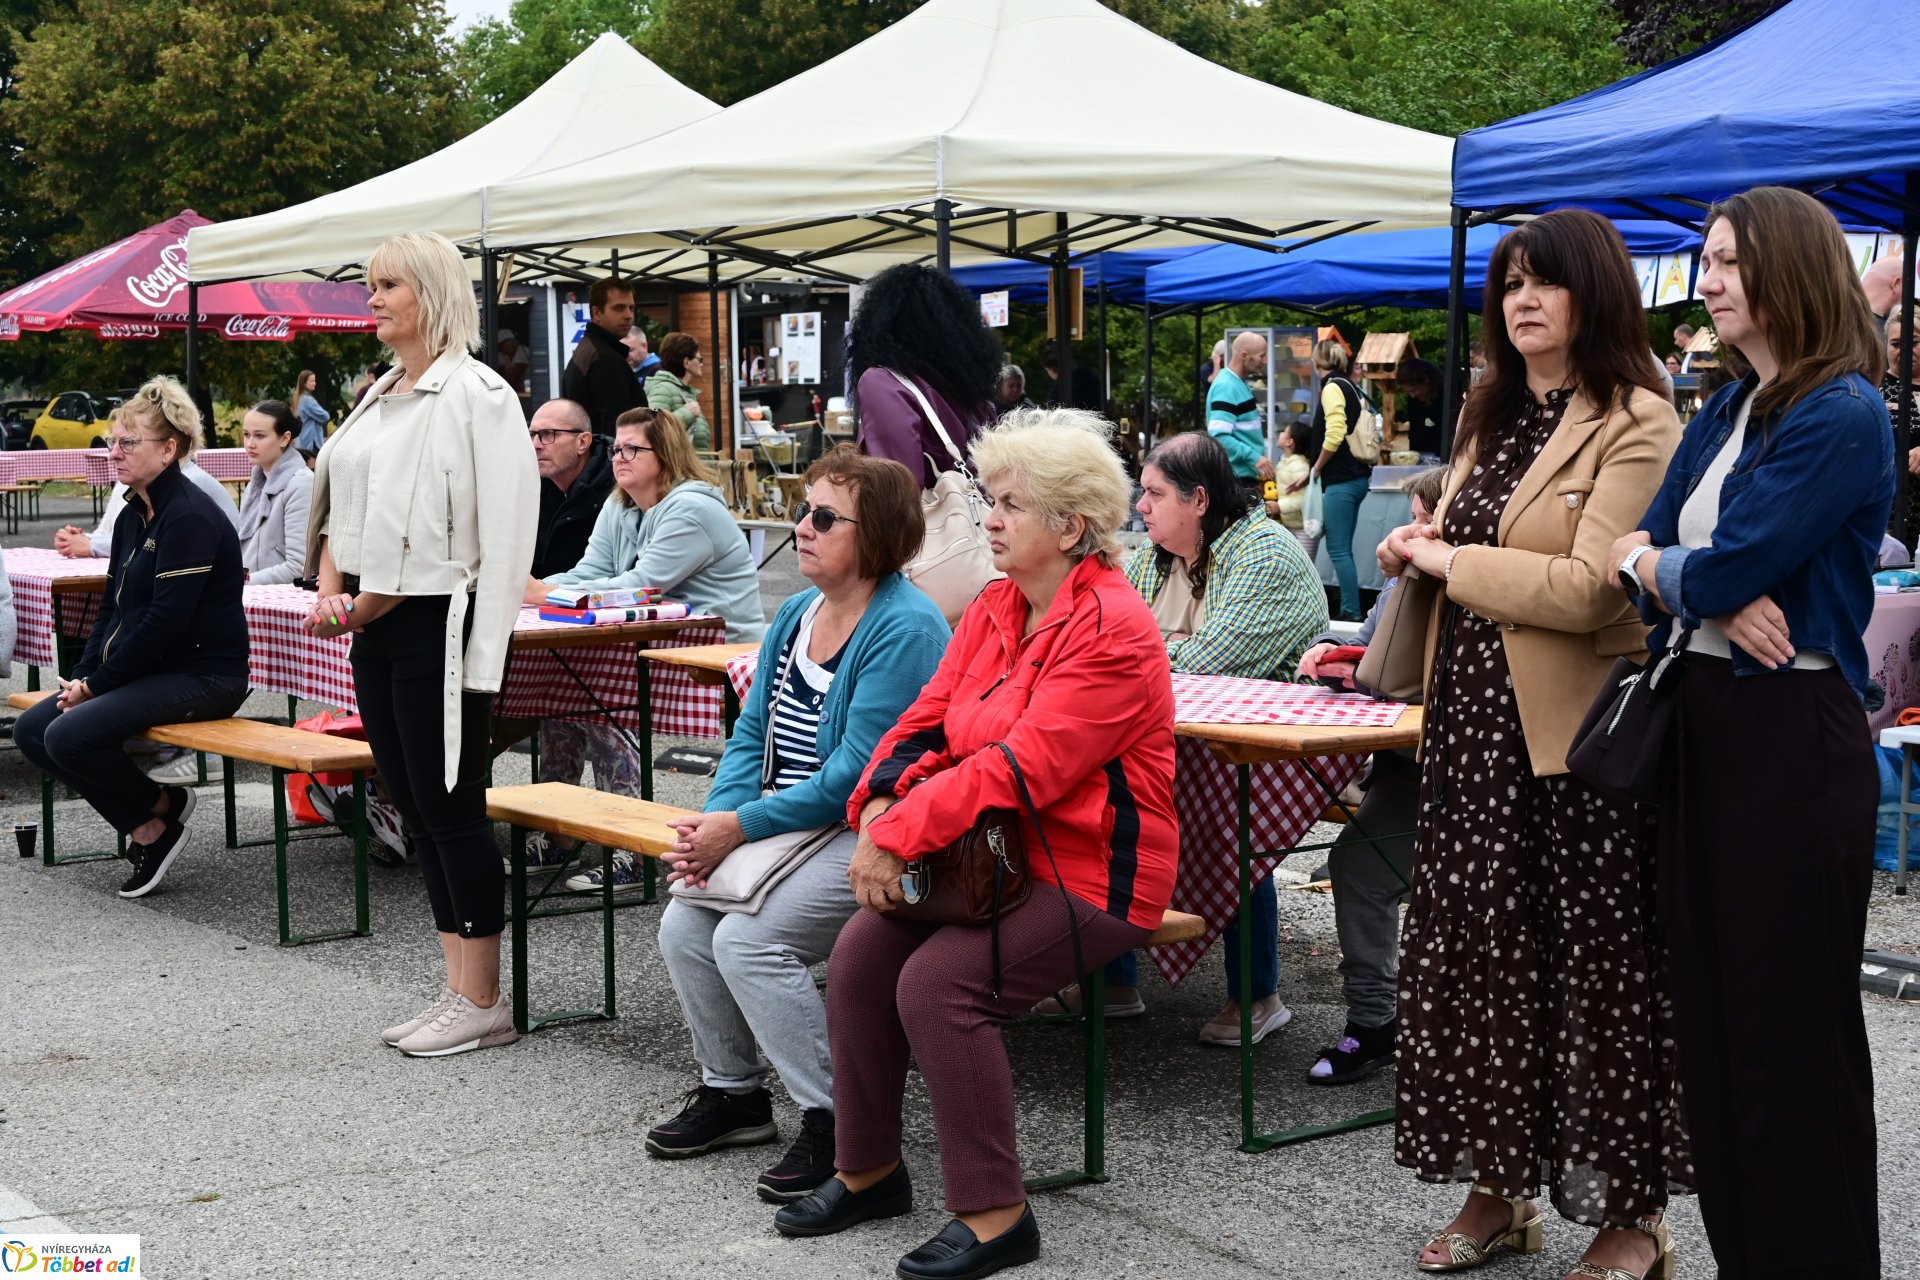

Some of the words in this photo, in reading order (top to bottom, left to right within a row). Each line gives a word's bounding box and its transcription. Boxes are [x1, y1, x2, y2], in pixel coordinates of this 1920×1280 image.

[153, 313, 174, 322] ICE
[176, 313, 208, 323] COD
[307, 317, 336, 327] SOLD
[337, 319, 369, 328] HERE
[225, 314, 292, 337] Coca-Cola
